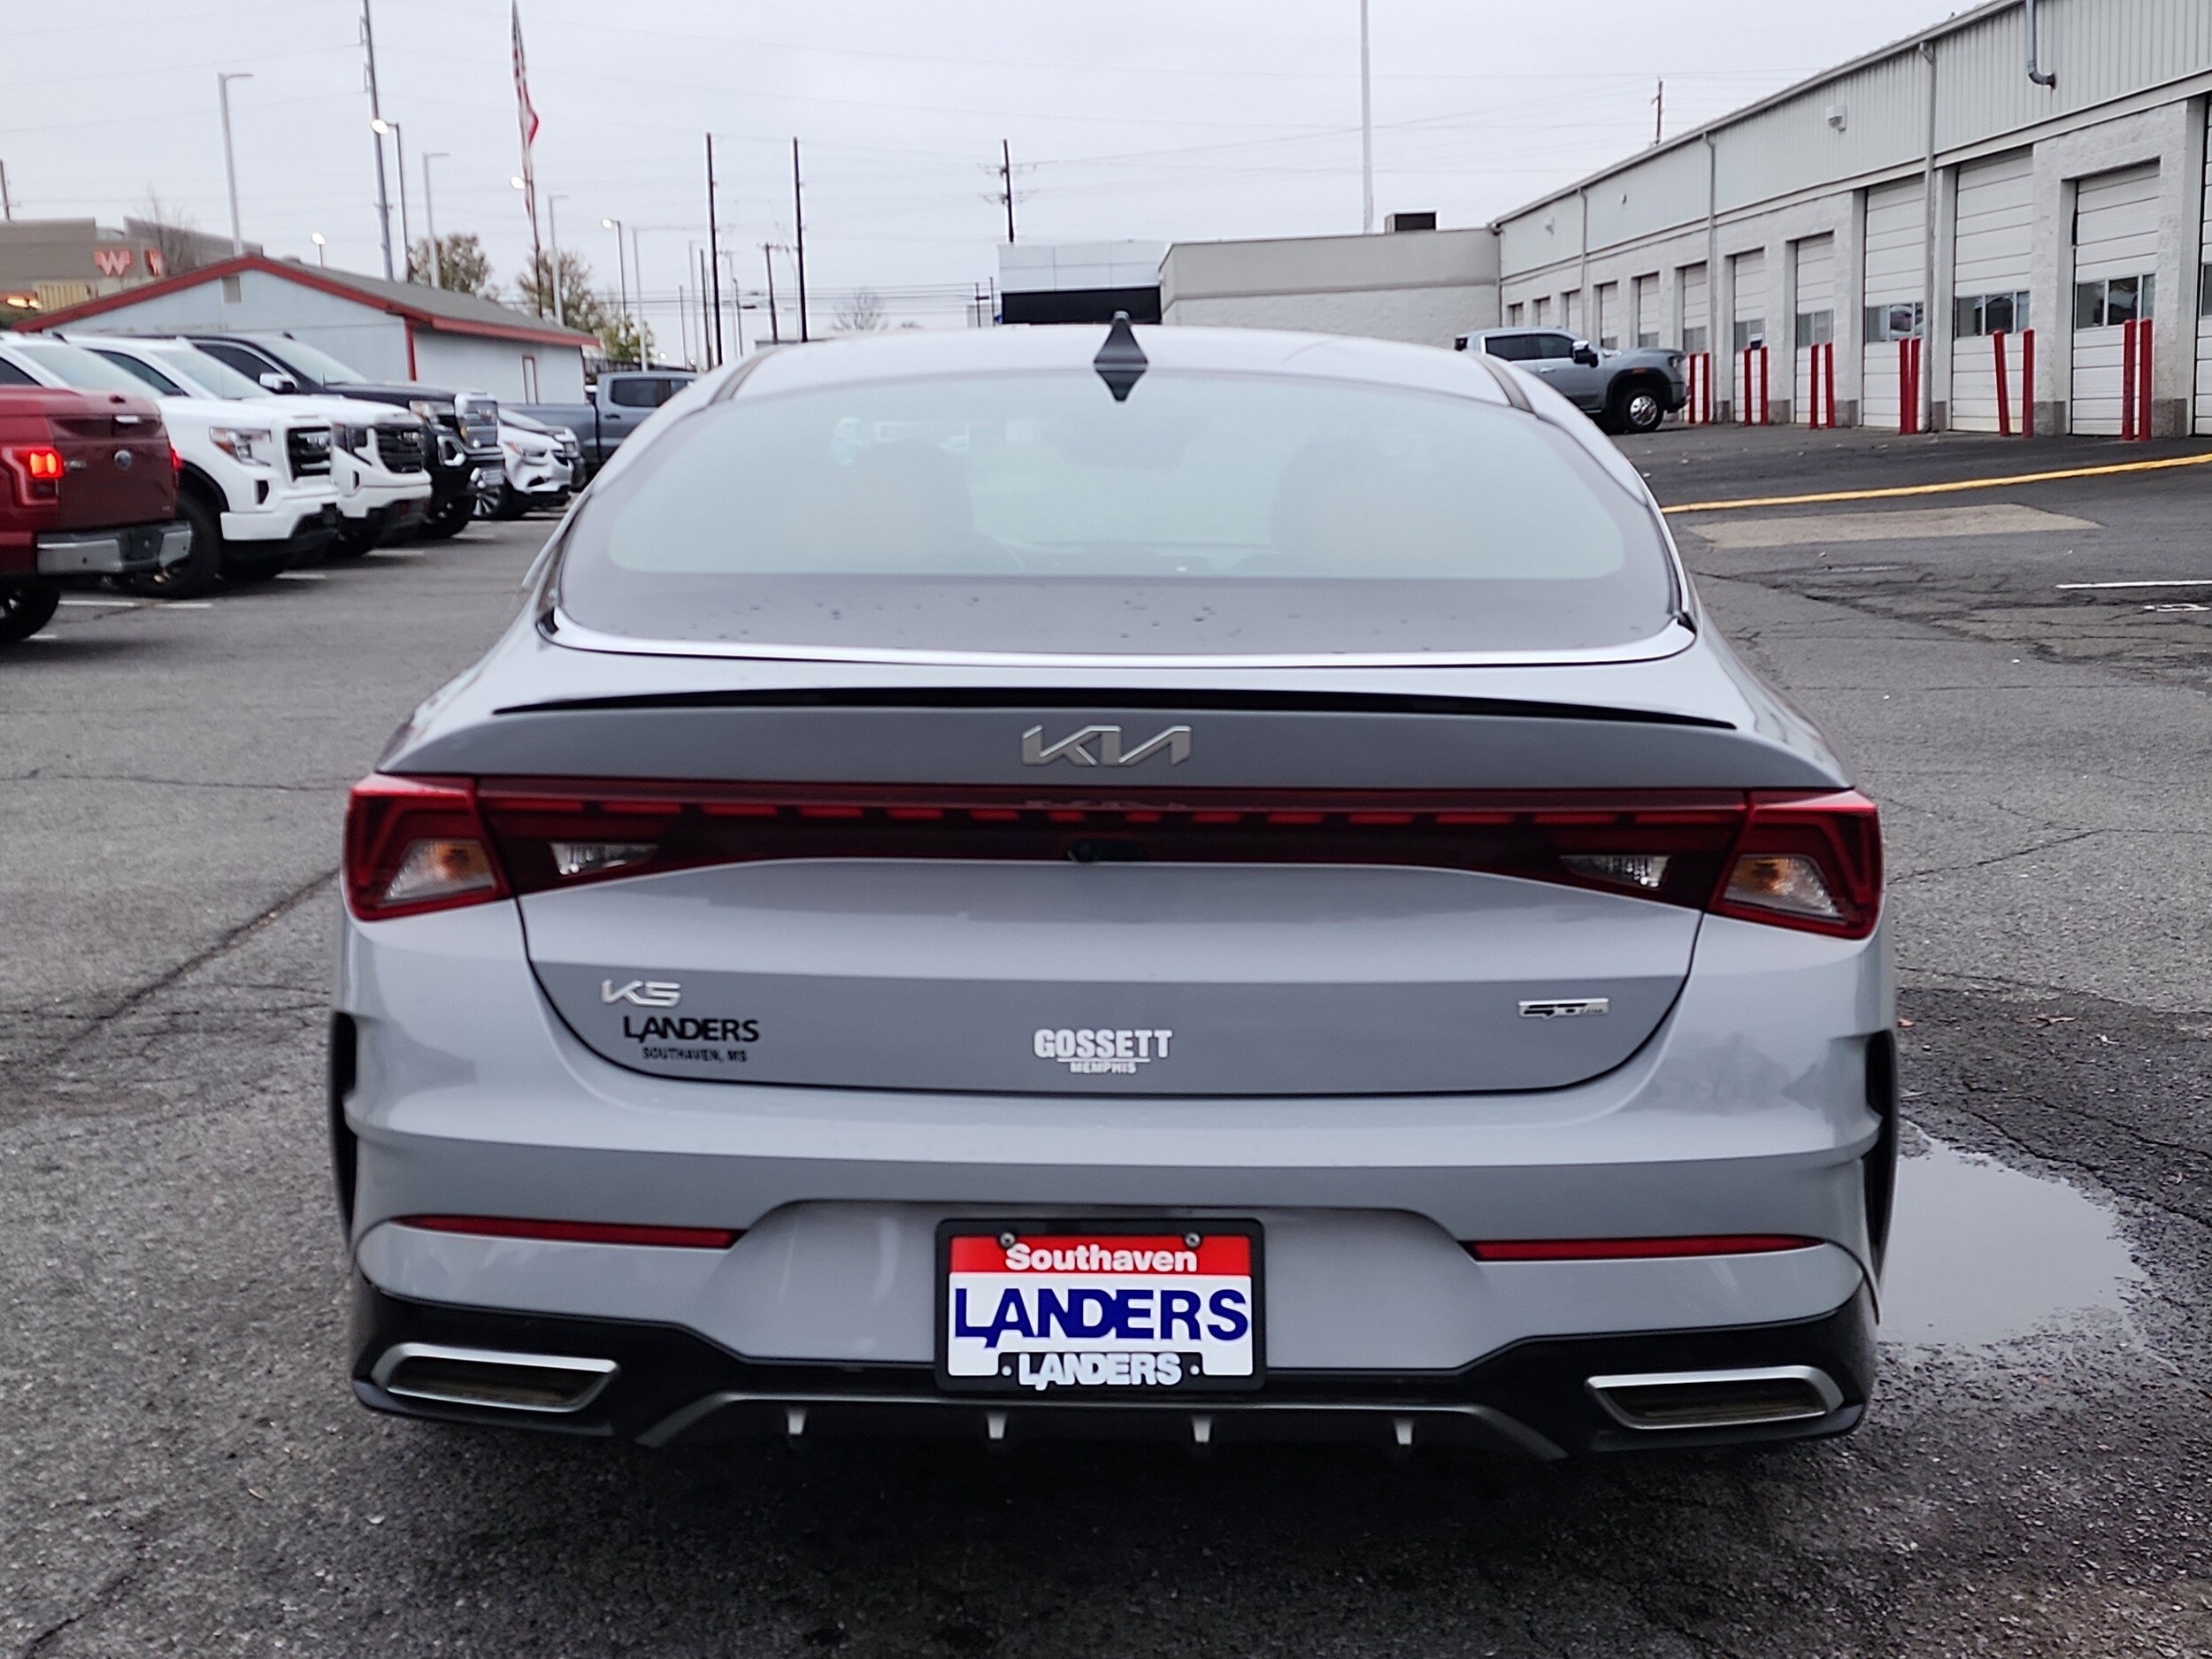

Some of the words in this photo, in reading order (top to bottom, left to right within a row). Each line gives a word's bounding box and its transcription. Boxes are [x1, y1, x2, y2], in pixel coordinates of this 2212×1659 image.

[94, 249, 131, 276] W
[1022, 725, 1192, 765] KIA
[602, 979, 681, 1008] K5
[623, 1016, 760, 1043] LANDERS
[1033, 1028, 1173, 1058] GOSSETT
[1070, 1062, 1137, 1074] MEMPHIS
[1005, 1243, 1197, 1272] Southaven
[955, 1287, 1249, 1348] LANDERS
[1018, 1352, 1182, 1391] LANDERS
